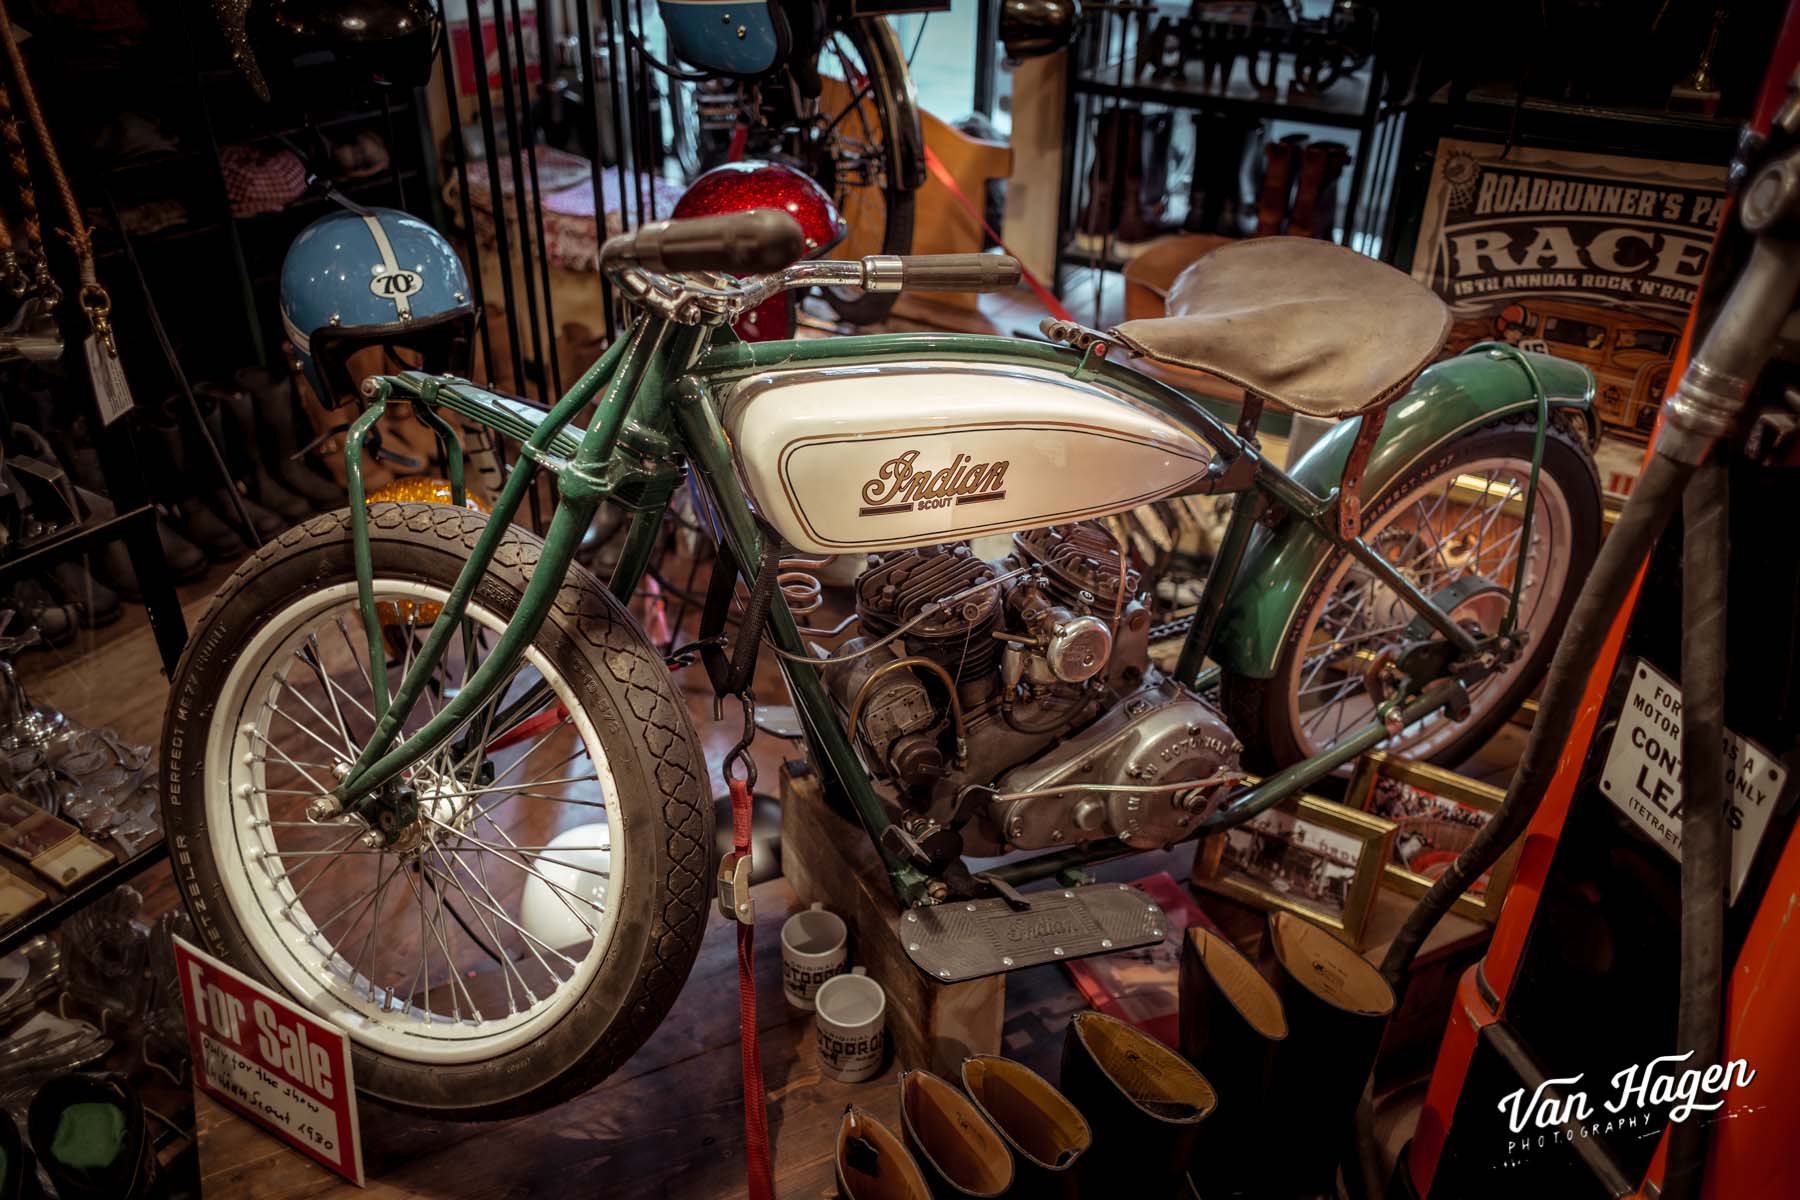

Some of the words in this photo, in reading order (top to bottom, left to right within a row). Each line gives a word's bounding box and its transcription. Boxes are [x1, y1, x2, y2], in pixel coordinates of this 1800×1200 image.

[1475, 172, 1685, 220] ROADRUNNER'S
[1450, 226, 1712, 286] RACE
[1503, 272, 1577, 289] ANNUAL
[1581, 273, 1633, 293] ROCK
[861, 450, 1010, 506] Indian
[917, 497, 953, 511] SCOUT
[169, 729, 185, 806] PERFECT
[1633, 694, 1681, 740] MOTOR
[1725, 769, 1767, 806] ONLY
[188, 959, 247, 1046] For
[253, 1000, 334, 1099] Sale
[250, 1091, 290, 1125] Scout
[255, 1067, 279, 1089] the
[283, 1088, 319, 1113] show
